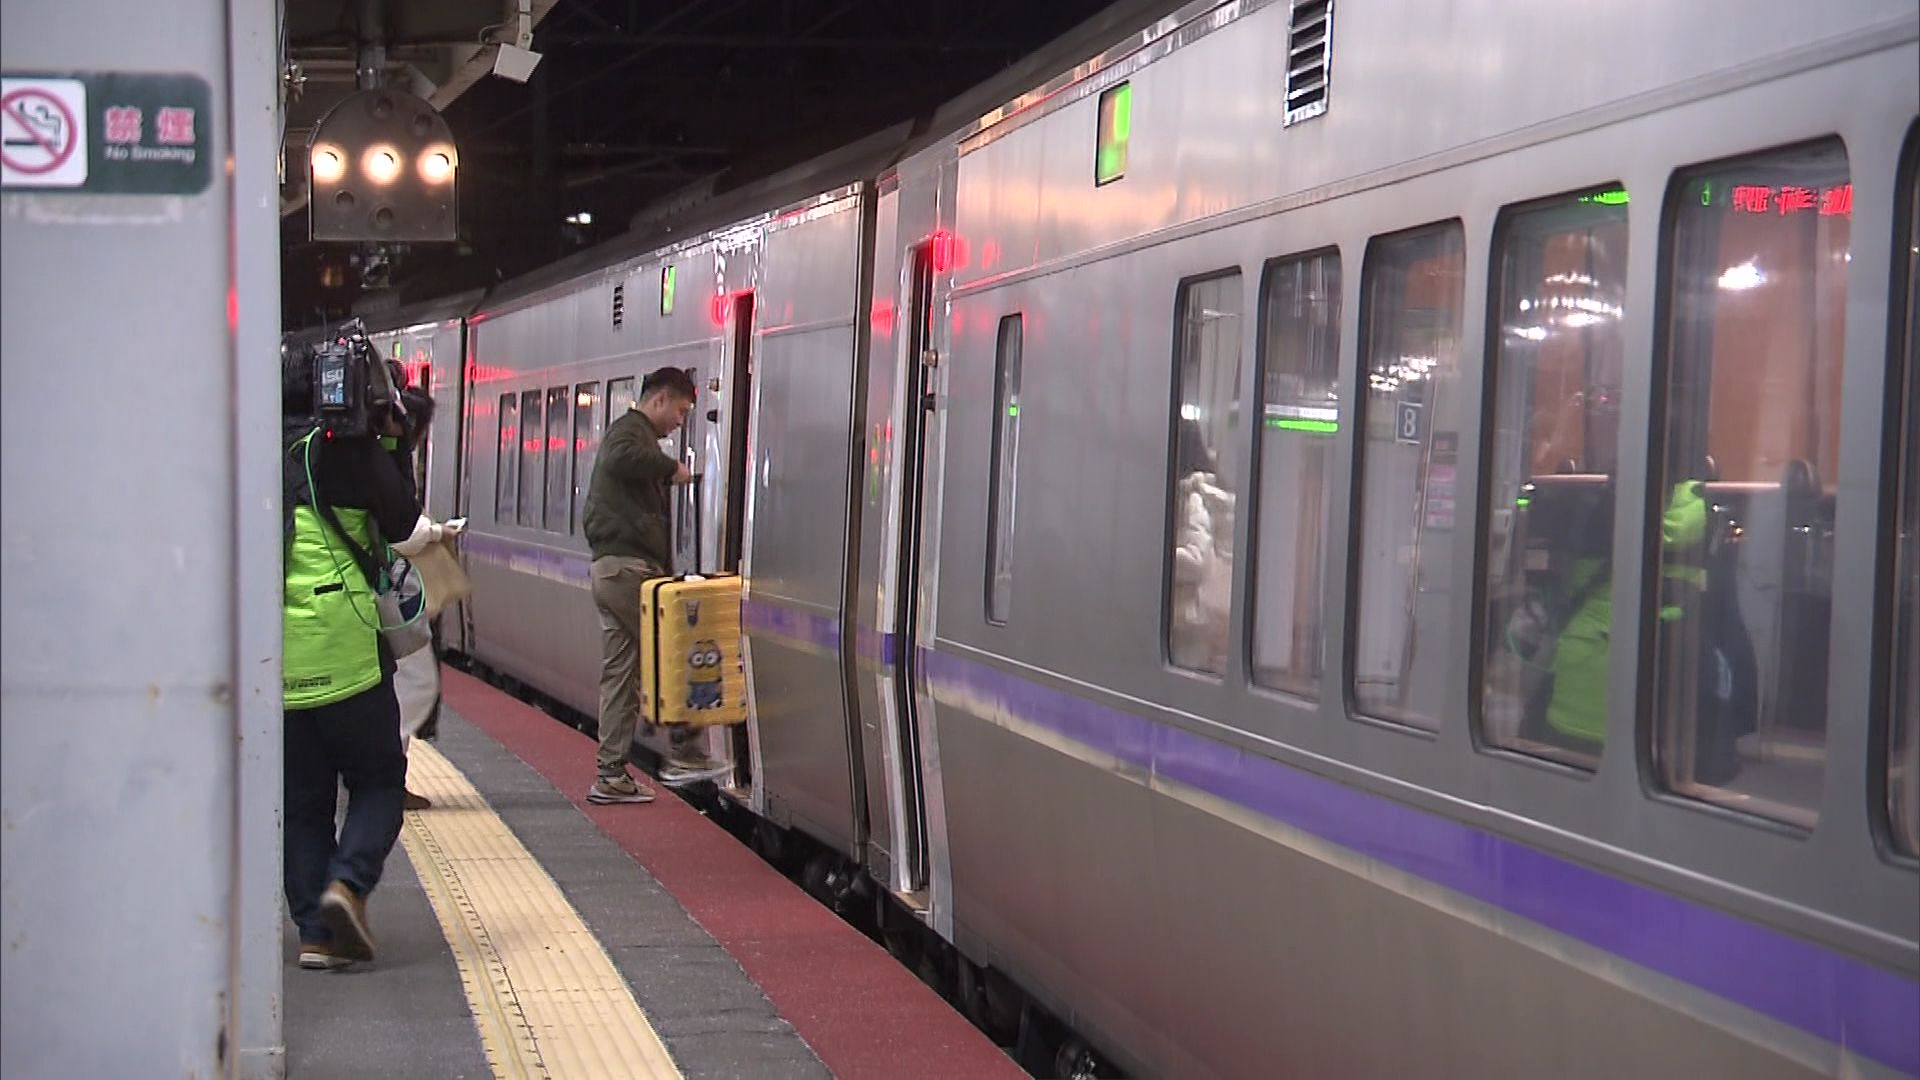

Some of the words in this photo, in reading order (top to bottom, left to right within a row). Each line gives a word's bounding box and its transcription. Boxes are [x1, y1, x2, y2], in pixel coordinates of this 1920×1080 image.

[105, 105, 195, 143] 禁煙
[104, 146, 129, 160] No
[131, 145, 196, 163] Smoking
[1404, 408, 1416, 438] 8
